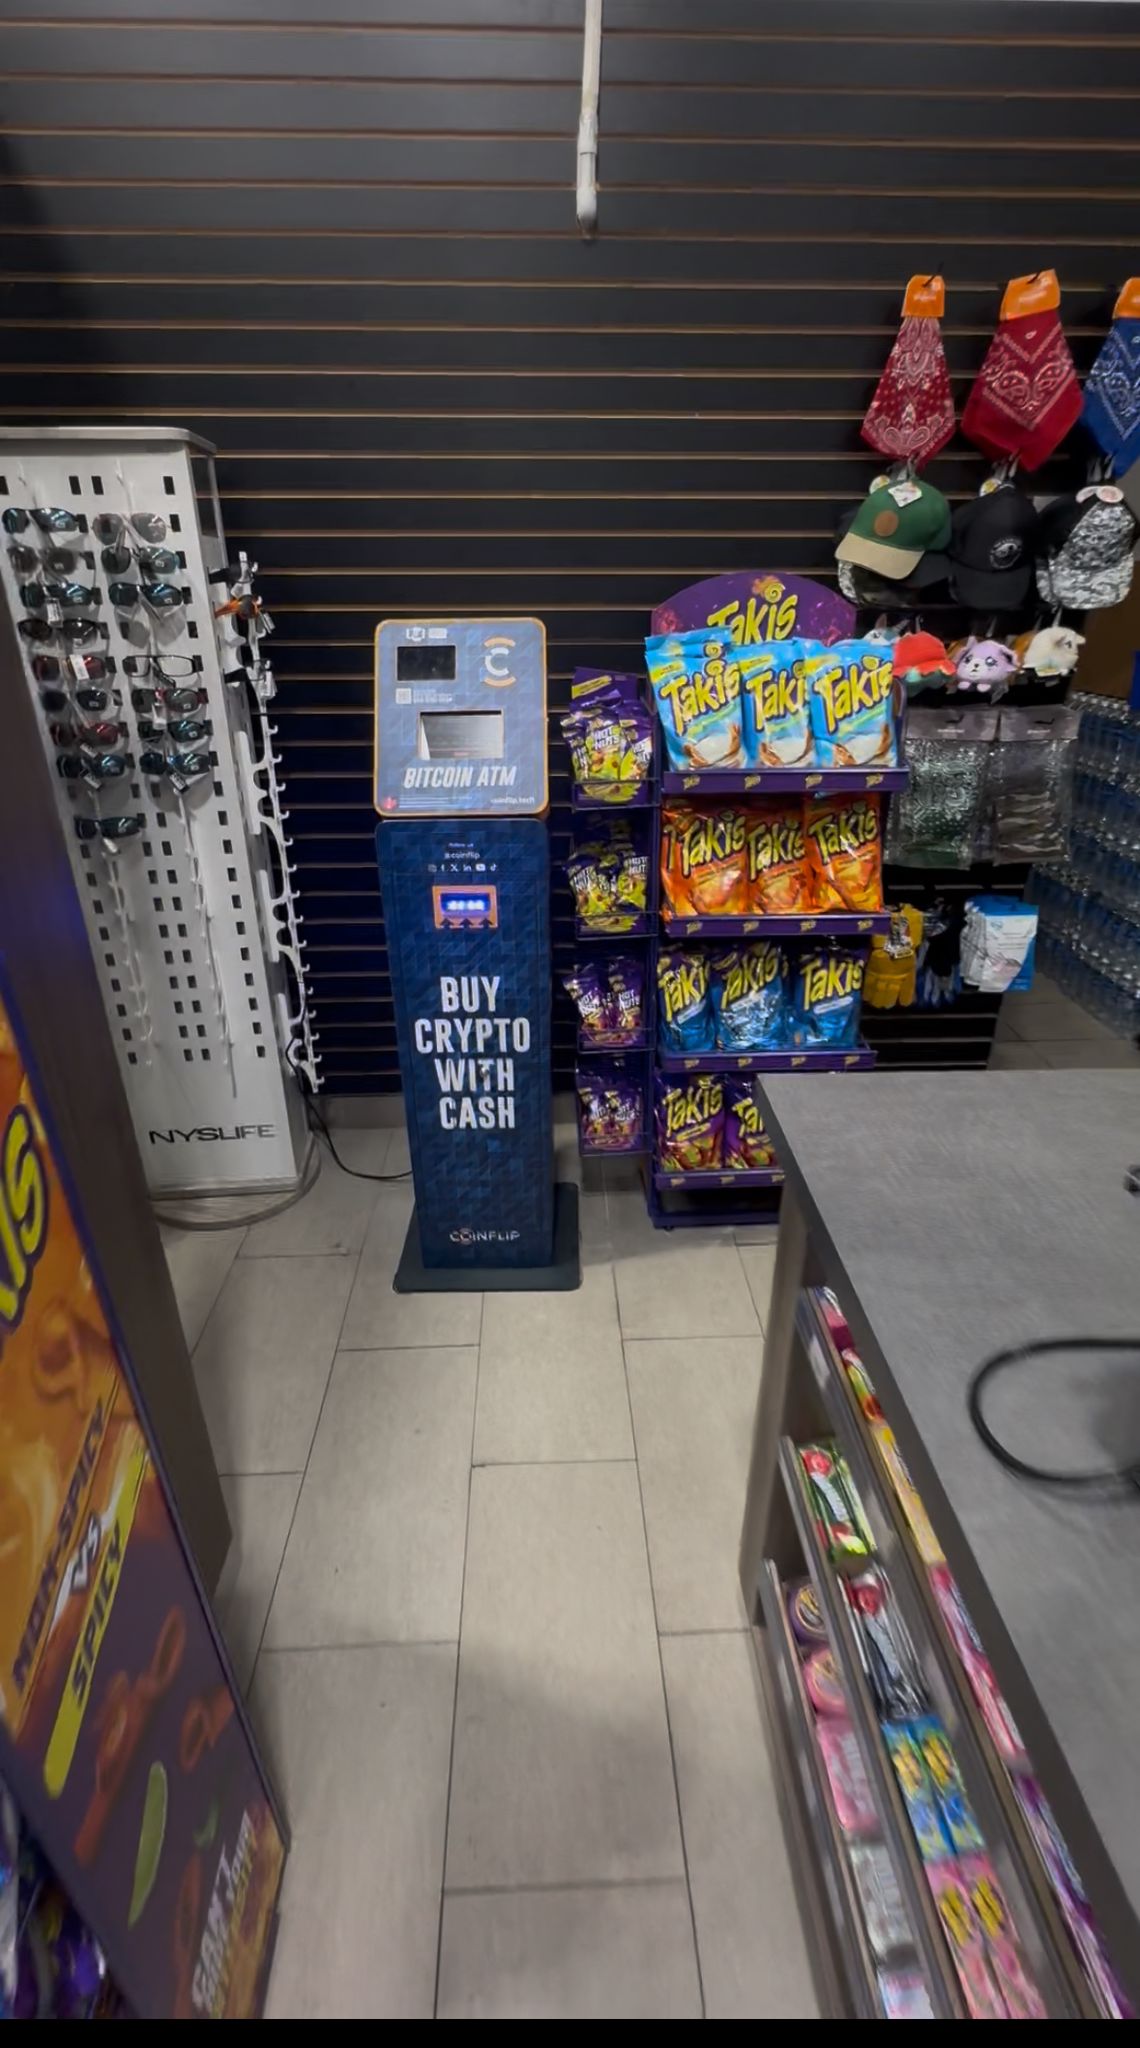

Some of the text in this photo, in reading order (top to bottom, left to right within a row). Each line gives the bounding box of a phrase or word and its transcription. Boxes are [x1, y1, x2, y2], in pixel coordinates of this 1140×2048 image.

[706, 582, 798, 644] Takis
[660, 659, 741, 735] Takis
[747, 662, 805, 730] Taki
[816, 657, 893, 732] Takis
[403, 765, 517, 789] BITCOIN ATM
[682, 811, 746, 875] Takis
[748, 818, 804, 880] Takis
[809, 802, 879, 864] Takis
[439, 975, 501, 1014] BUY
[721, 943, 777, 1009] Takis
[801, 957, 865, 1010] Takis
[414, 1017, 531, 1054] CRYPTO
[434, 1058, 515, 1092] WITH
[148, 1124, 277, 1144] NYSLIFE
[439, 1097, 516, 1129] CASH
[662, 1076, 722, 1138] Takis
[449, 1229, 521, 1244] COINFLIP
[12, 1398, 104, 1696] NON-SPICY
[71, 1512, 100, 1592] VS
[72, 1519, 120, 1705] SPICY
